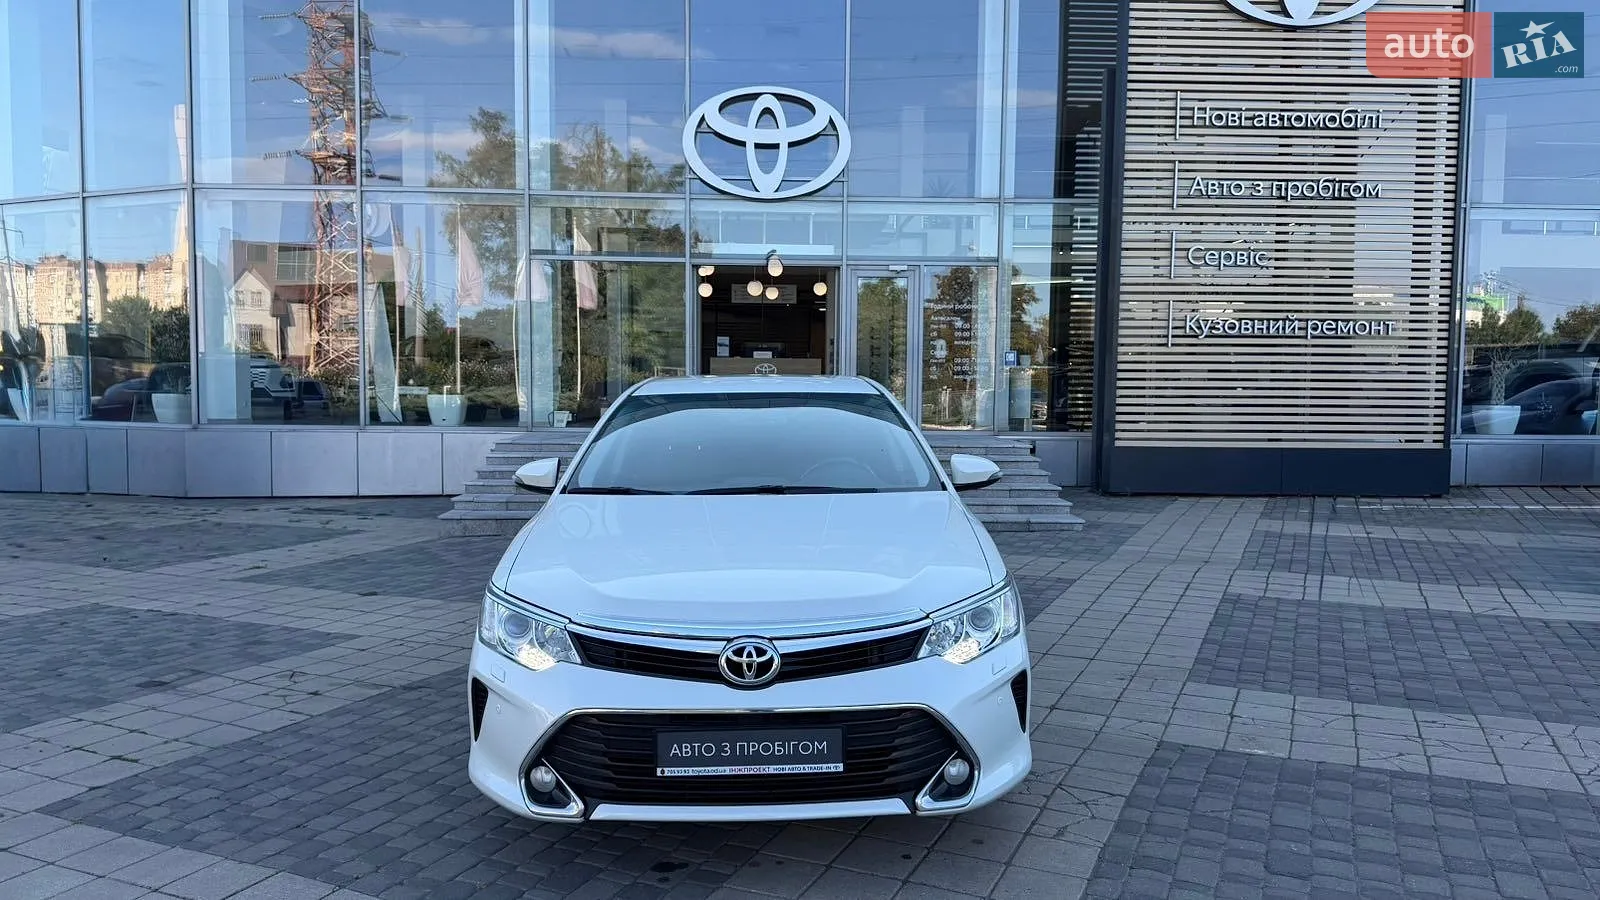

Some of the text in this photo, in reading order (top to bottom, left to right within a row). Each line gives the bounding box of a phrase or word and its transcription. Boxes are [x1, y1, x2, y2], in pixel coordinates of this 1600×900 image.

[1193, 105, 1383, 129] Нові автомобілі
[1189, 175, 1382, 201] Авто з пробігом
[1187, 245, 1269, 271] Сервіс
[1184, 313, 1396, 340] Кузовний ремонт
[670, 741, 827, 757] АВТО З ПРОБІГОМ
